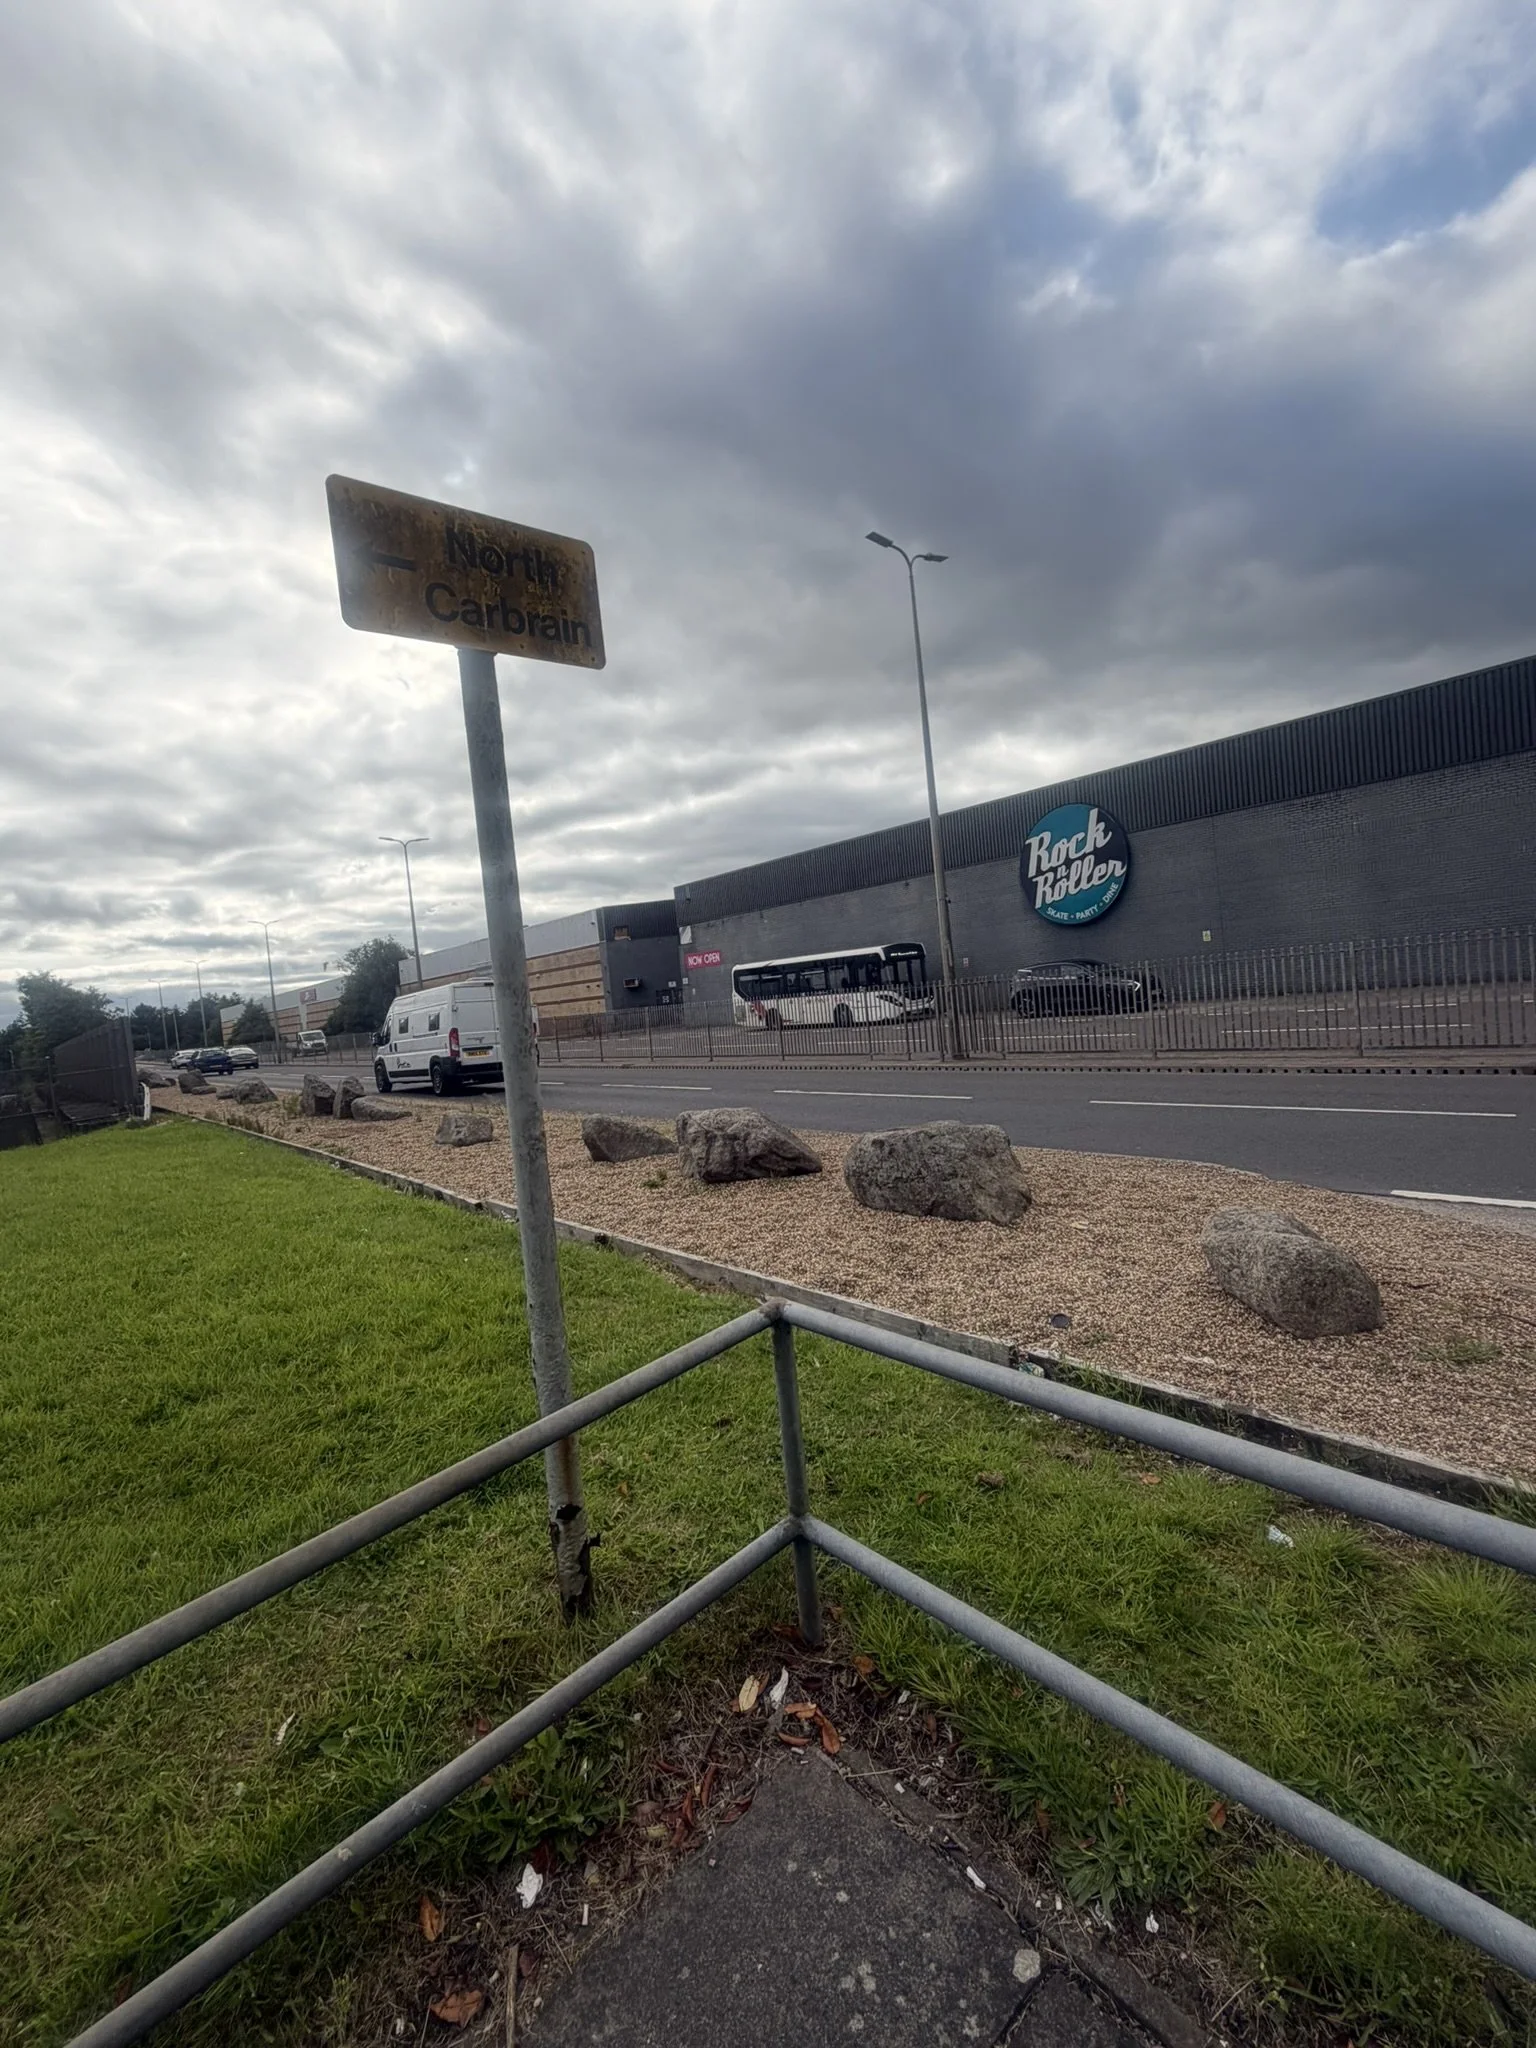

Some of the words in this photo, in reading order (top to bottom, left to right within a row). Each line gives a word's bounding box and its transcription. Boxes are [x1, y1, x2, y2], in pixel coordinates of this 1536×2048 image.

[444, 524, 559, 588] North
[424, 581, 593, 648] Carbrain
[1025, 807, 1112, 878] Rock
[1032, 854, 1127, 909] Roller
[1046, 906, 1069, 920] SKATE
[1076, 905, 1099, 920] PARTY
[1102, 882, 1119, 903] DINE
[687, 955, 703, 966] NOW
[703, 952, 721, 964] OPEN
